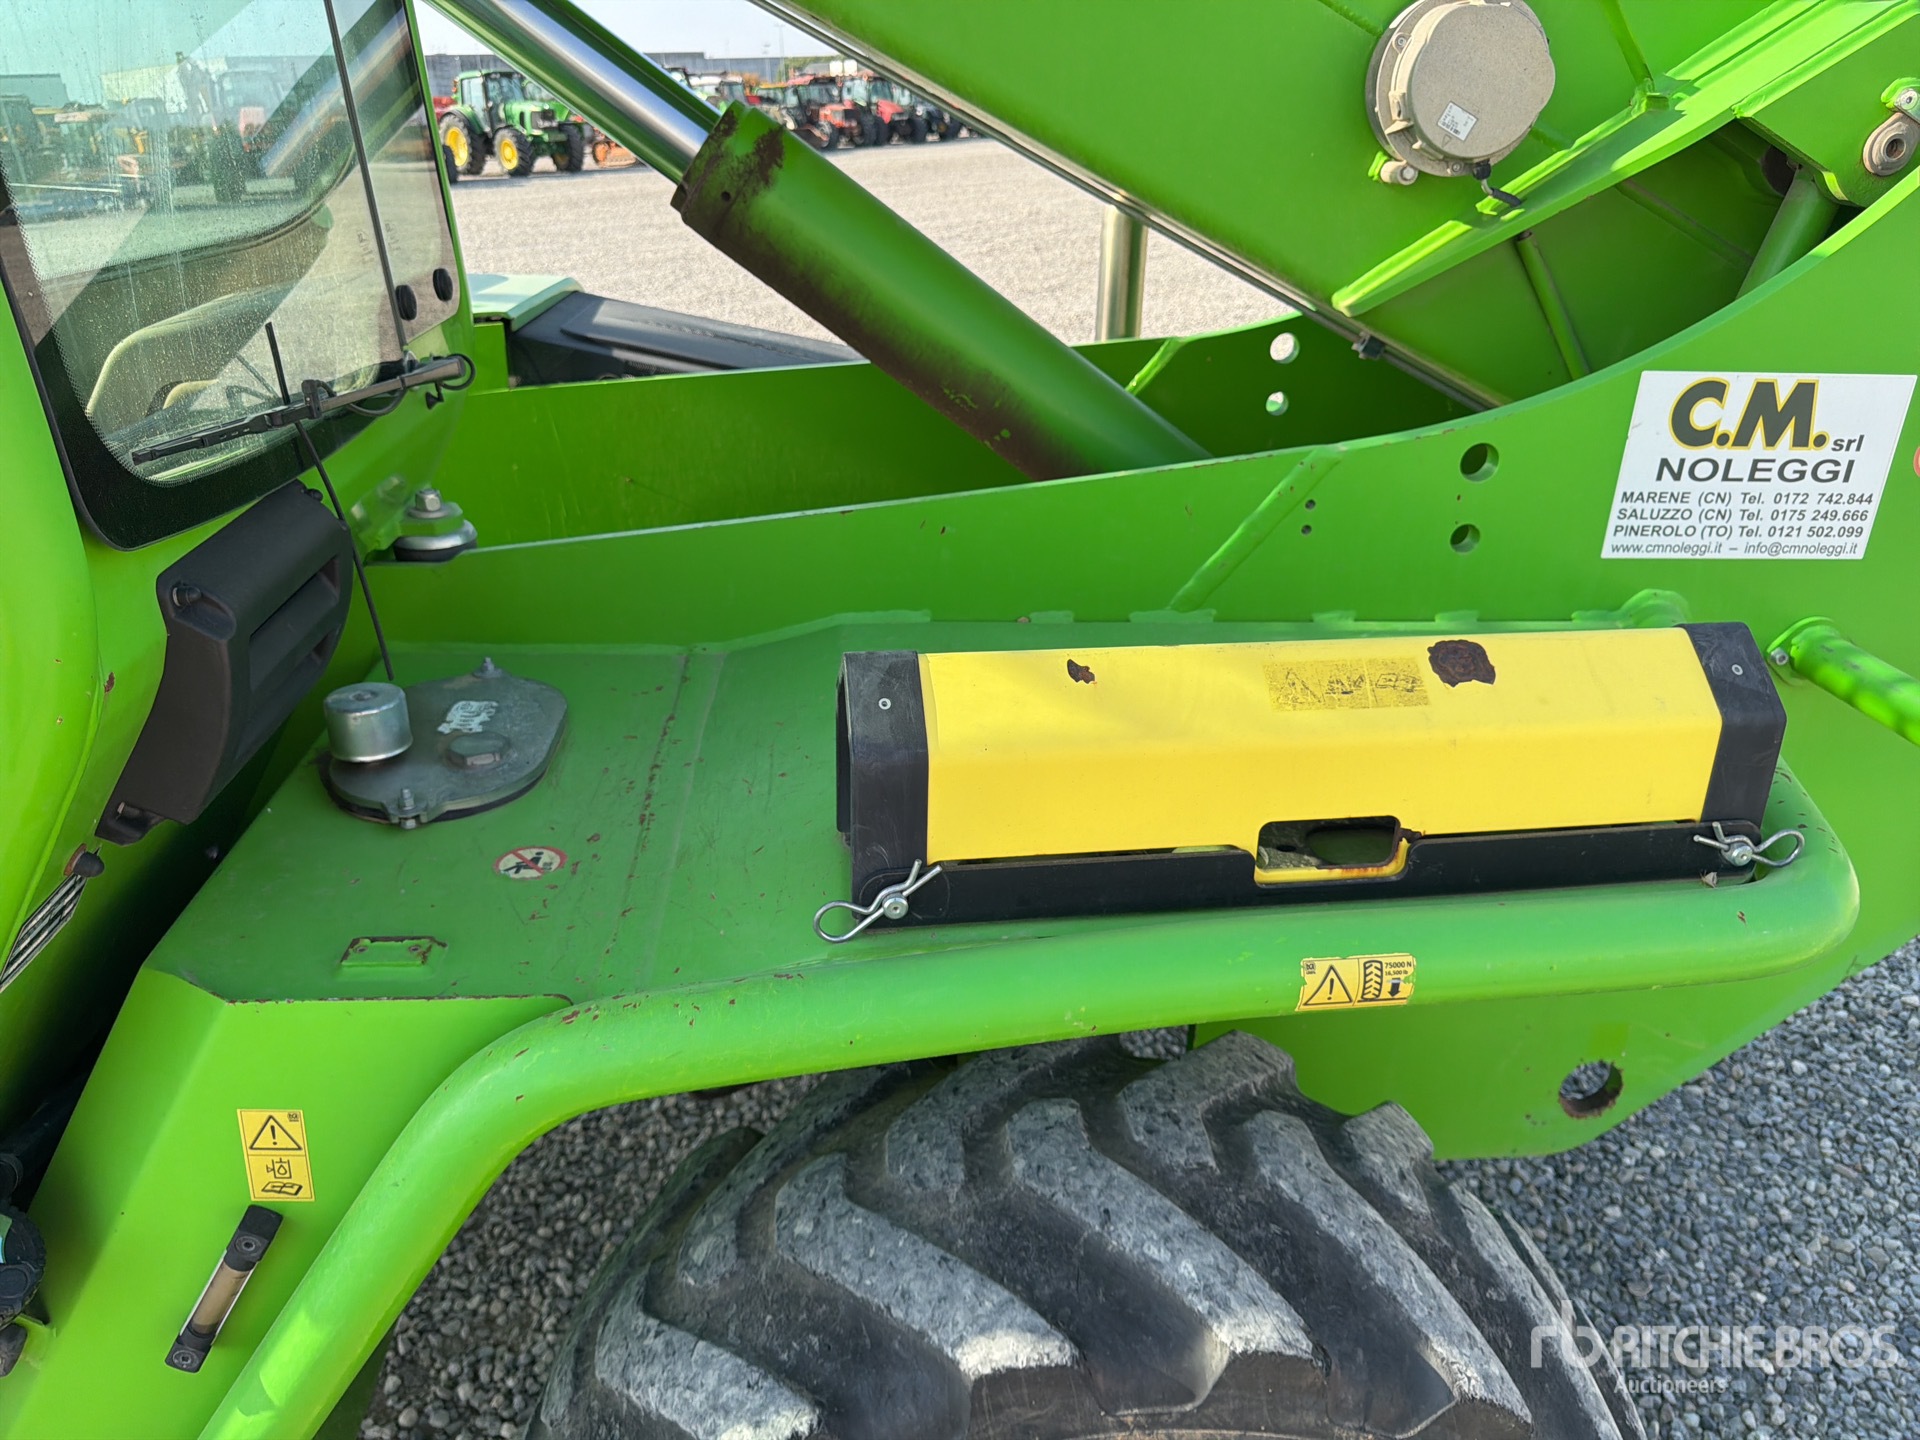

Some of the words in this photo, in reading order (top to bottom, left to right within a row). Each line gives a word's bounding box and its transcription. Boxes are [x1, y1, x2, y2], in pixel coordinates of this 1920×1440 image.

[1669, 376, 1830, 451] C.M.
[1831, 435, 1864, 452] srl
[1656, 457, 1855, 483] NOLEGGI
[1620, 491, 1691, 504] MARENE
[1698, 491, 1732, 506] (CN)
[1741, 492, 1765, 505] Tel.
[1773, 493, 1809, 505] 0172
[1817, 493, 1873, 506] 742.844
[1617, 508, 1692, 521] SALUZZO
[1698, 508, 1732, 522] (CN)
[1740, 509, 1764, 521] Tel.
[1770, 509, 1806, 521] 0175
[1811, 509, 1868, 522] 249.666
[1613, 525, 1696, 537] PINEROLO
[1700, 525, 1733, 539] (TO)
[1738, 525, 1762, 538] Tel.
[1767, 526, 1801, 538] 0121
[1806, 526, 1863, 538] 502.099
[1611, 541, 1722, 556] www.cmnoleggi.it
[1744, 541, 1858, 557] info@cmnoleggi.it
